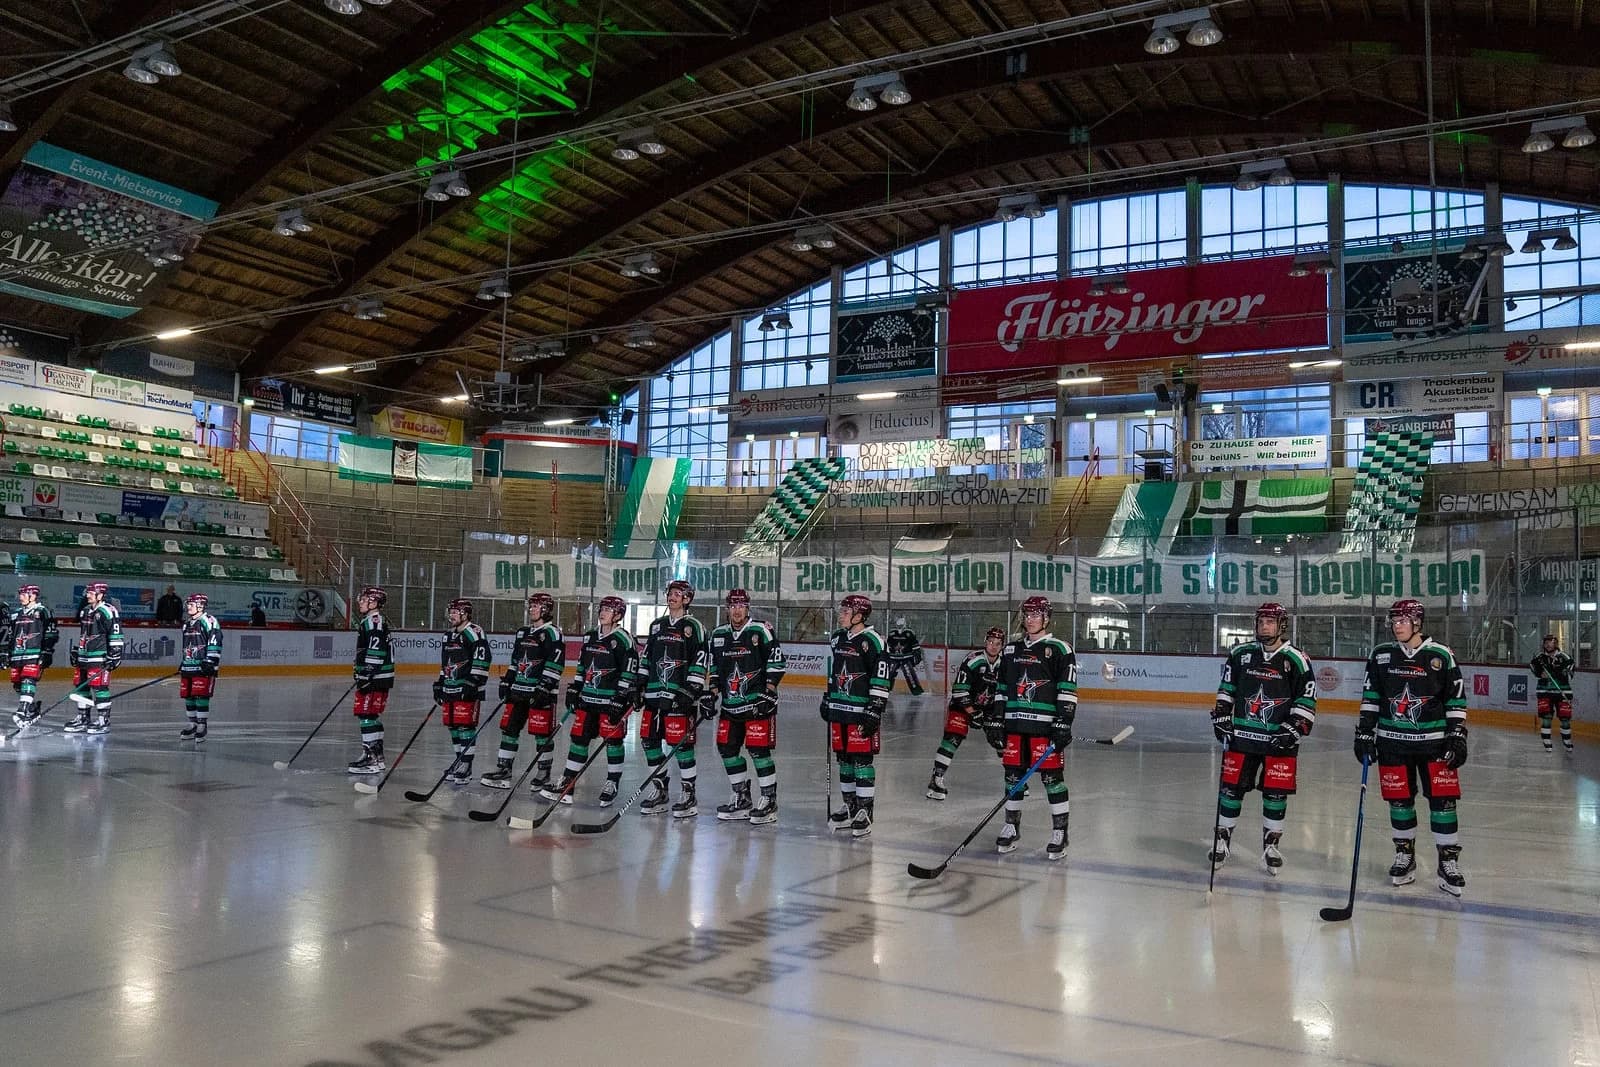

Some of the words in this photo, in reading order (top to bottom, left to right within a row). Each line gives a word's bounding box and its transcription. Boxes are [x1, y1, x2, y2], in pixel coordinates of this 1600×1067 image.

[69, 158, 183, 207] Event-Mietservice
[90, 283, 136, 302] Service
[997, 291, 1266, 352] Flötzinger
[52, 378, 82, 390] TASCHNER
[1422, 376, 1496, 387] Trockenbau
[1360, 381, 1395, 409] CR
[1423, 386, 1495, 397] Akustikbau
[147, 395, 193, 409] TechnoMarkt
[1191, 441, 1204, 450] Ob
[1209, 441, 1222, 449] ZU
[1223, 440, 1255, 448] HAUSE
[1257, 439, 1278, 447] oder
[1291, 438, 1314, 446] HIER
[896, 454, 925, 468] FANS
[1191, 454, 1204, 462] DU
[1210, 453, 1223, 461] bei
[1223, 452, 1241, 461] UNS
[1256, 452, 1275, 460] WIR
[1276, 451, 1290, 459] bei
[830, 478, 852, 494] DAS
[850, 492, 898, 508] BANNER
[951, 487, 1050, 506] CORONA-ZEIT
[1439, 487, 1558, 513] GEMEINSAM
[495, 560, 560, 590] Auch
[575, 554, 597, 588] in
[899, 558, 1005, 593] werden
[1021, 554, 1072, 592] wir
[1090, 558, 1162, 595] euch
[1301, 553, 1481, 600] begleiten!
[252, 590, 282, 611] SVR
[113, 623, 120, 635] 9
[767, 647, 782, 663] 28
[626, 657, 638, 674] 18
[1113, 667, 1148, 678] ISOMA
[1510, 682, 1526, 694] ACP
[1385, 730, 1426, 740] ROSENHEIM
